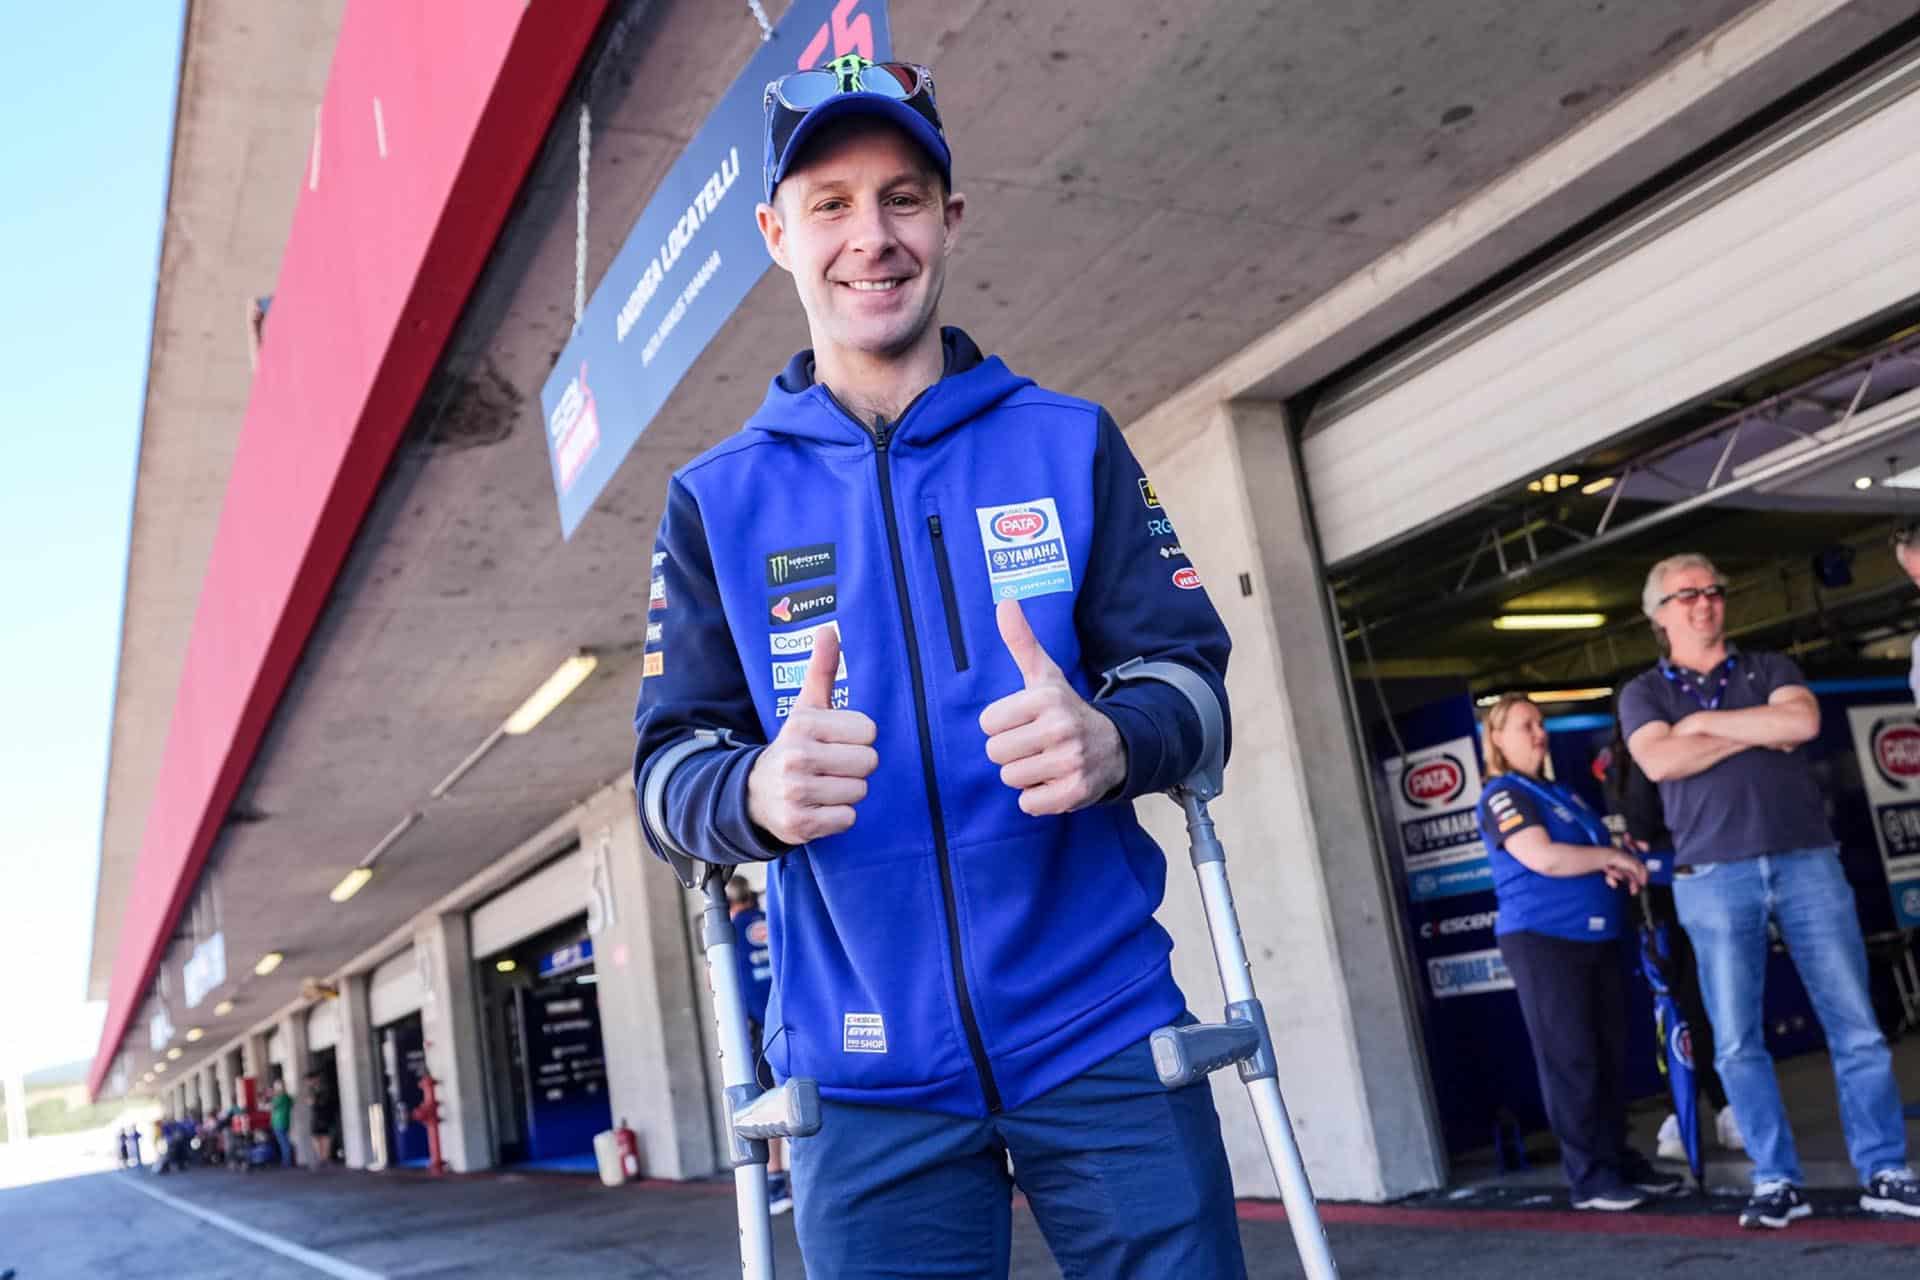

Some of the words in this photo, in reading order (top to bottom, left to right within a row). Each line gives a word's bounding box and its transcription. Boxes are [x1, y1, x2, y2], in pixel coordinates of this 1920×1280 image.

[616, 258, 664, 343] ANDREA
[661, 147, 740, 272] LOCATELLI
[1001, 516, 1037, 533] PATA
[788, 552, 831, 566] MONSTER
[1008, 542, 1059, 562] YAMAHA
[792, 595, 834, 613] AMPITO
[774, 634, 814, 650] Corp
[1411, 767, 1455, 797] PATA
